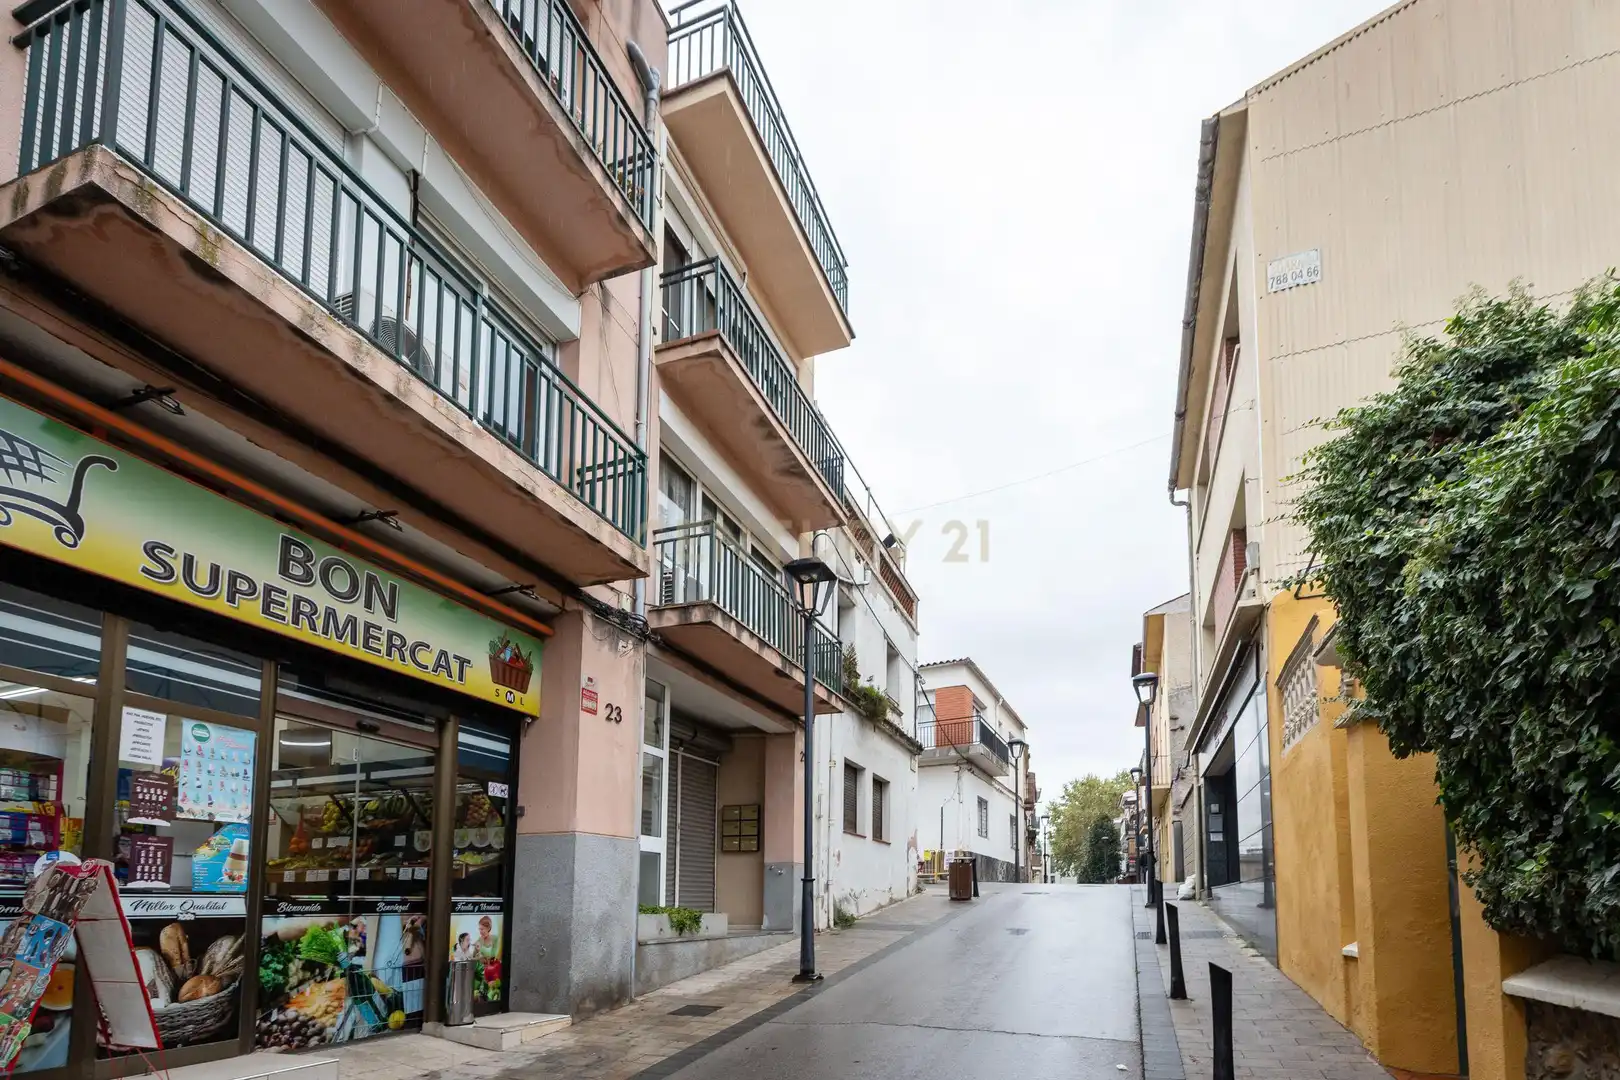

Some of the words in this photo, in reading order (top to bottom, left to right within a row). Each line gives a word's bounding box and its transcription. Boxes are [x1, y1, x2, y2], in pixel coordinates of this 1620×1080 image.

[1270, 272, 1289, 290] 788
[1306, 265, 1319, 279] 66
[278, 532, 400, 622] BON
[140, 540, 473, 685] SUPERMERCAT
[494, 688, 500, 697] S
[506, 692, 514, 703] M
[519, 697, 525, 706] L
[605, 702, 623, 724] 23
[799, 750, 805, 763] 2
[129, 899, 176, 912] Millor
[276, 901, 322, 913] Bienvenido
